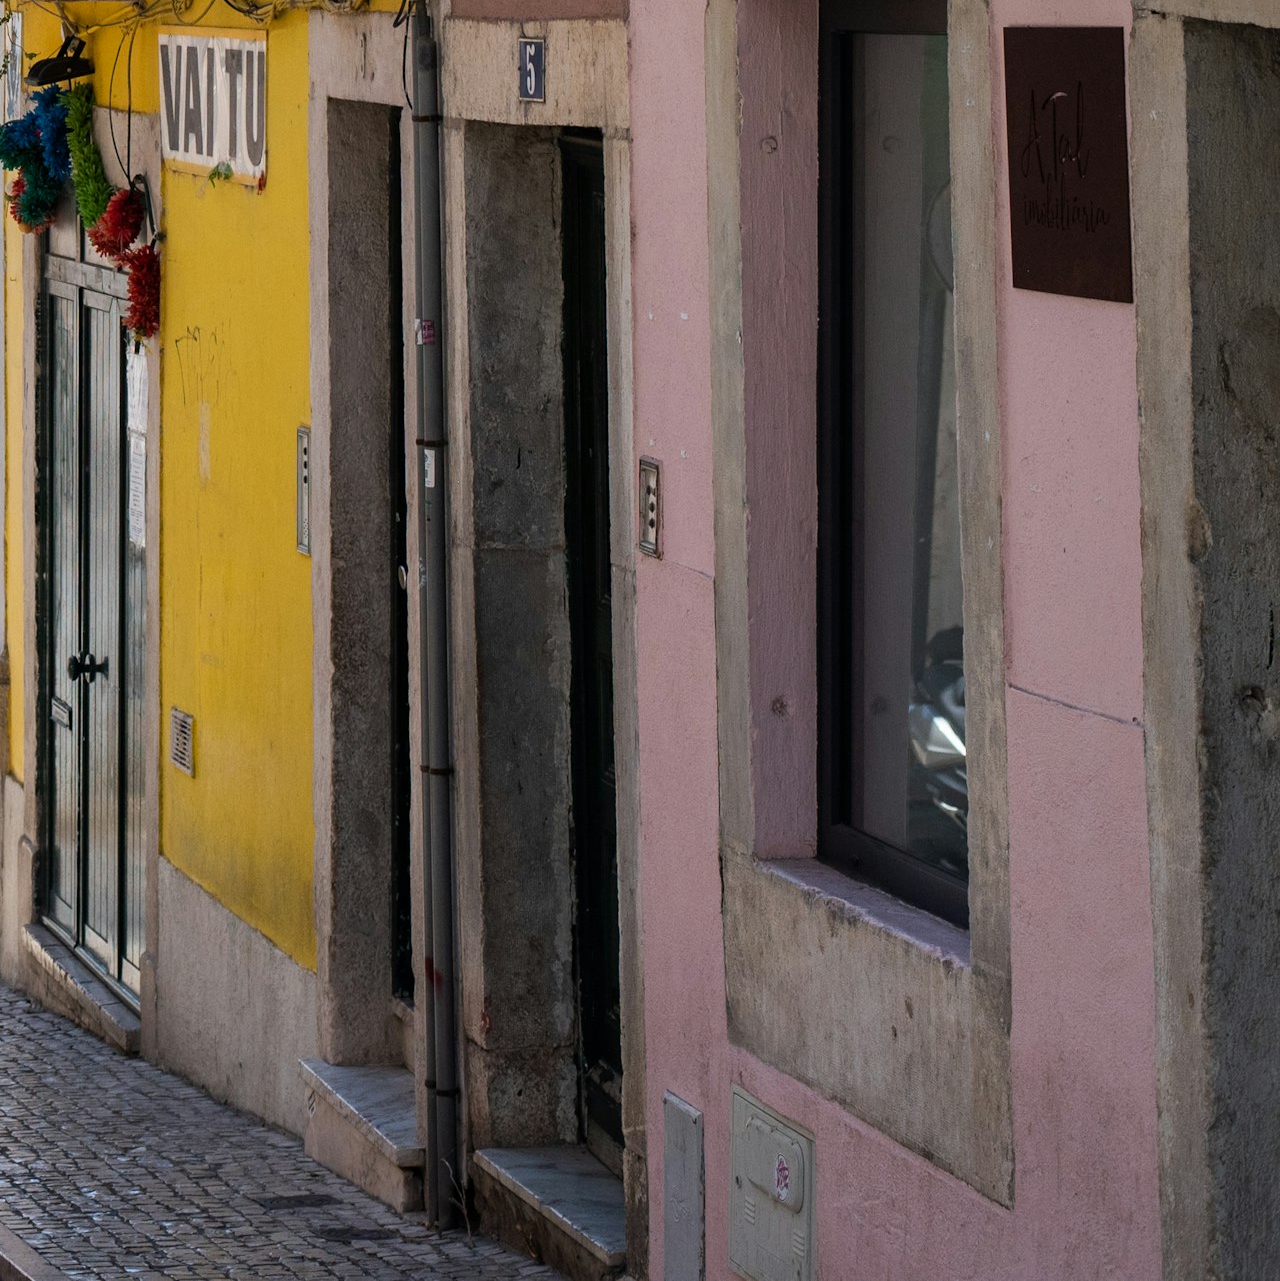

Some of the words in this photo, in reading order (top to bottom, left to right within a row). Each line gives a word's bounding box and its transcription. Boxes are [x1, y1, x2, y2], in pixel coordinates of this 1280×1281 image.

[160, 44, 214, 157] VAI
[225, 49, 265, 167] TU
[526, 44, 536, 95] 5
